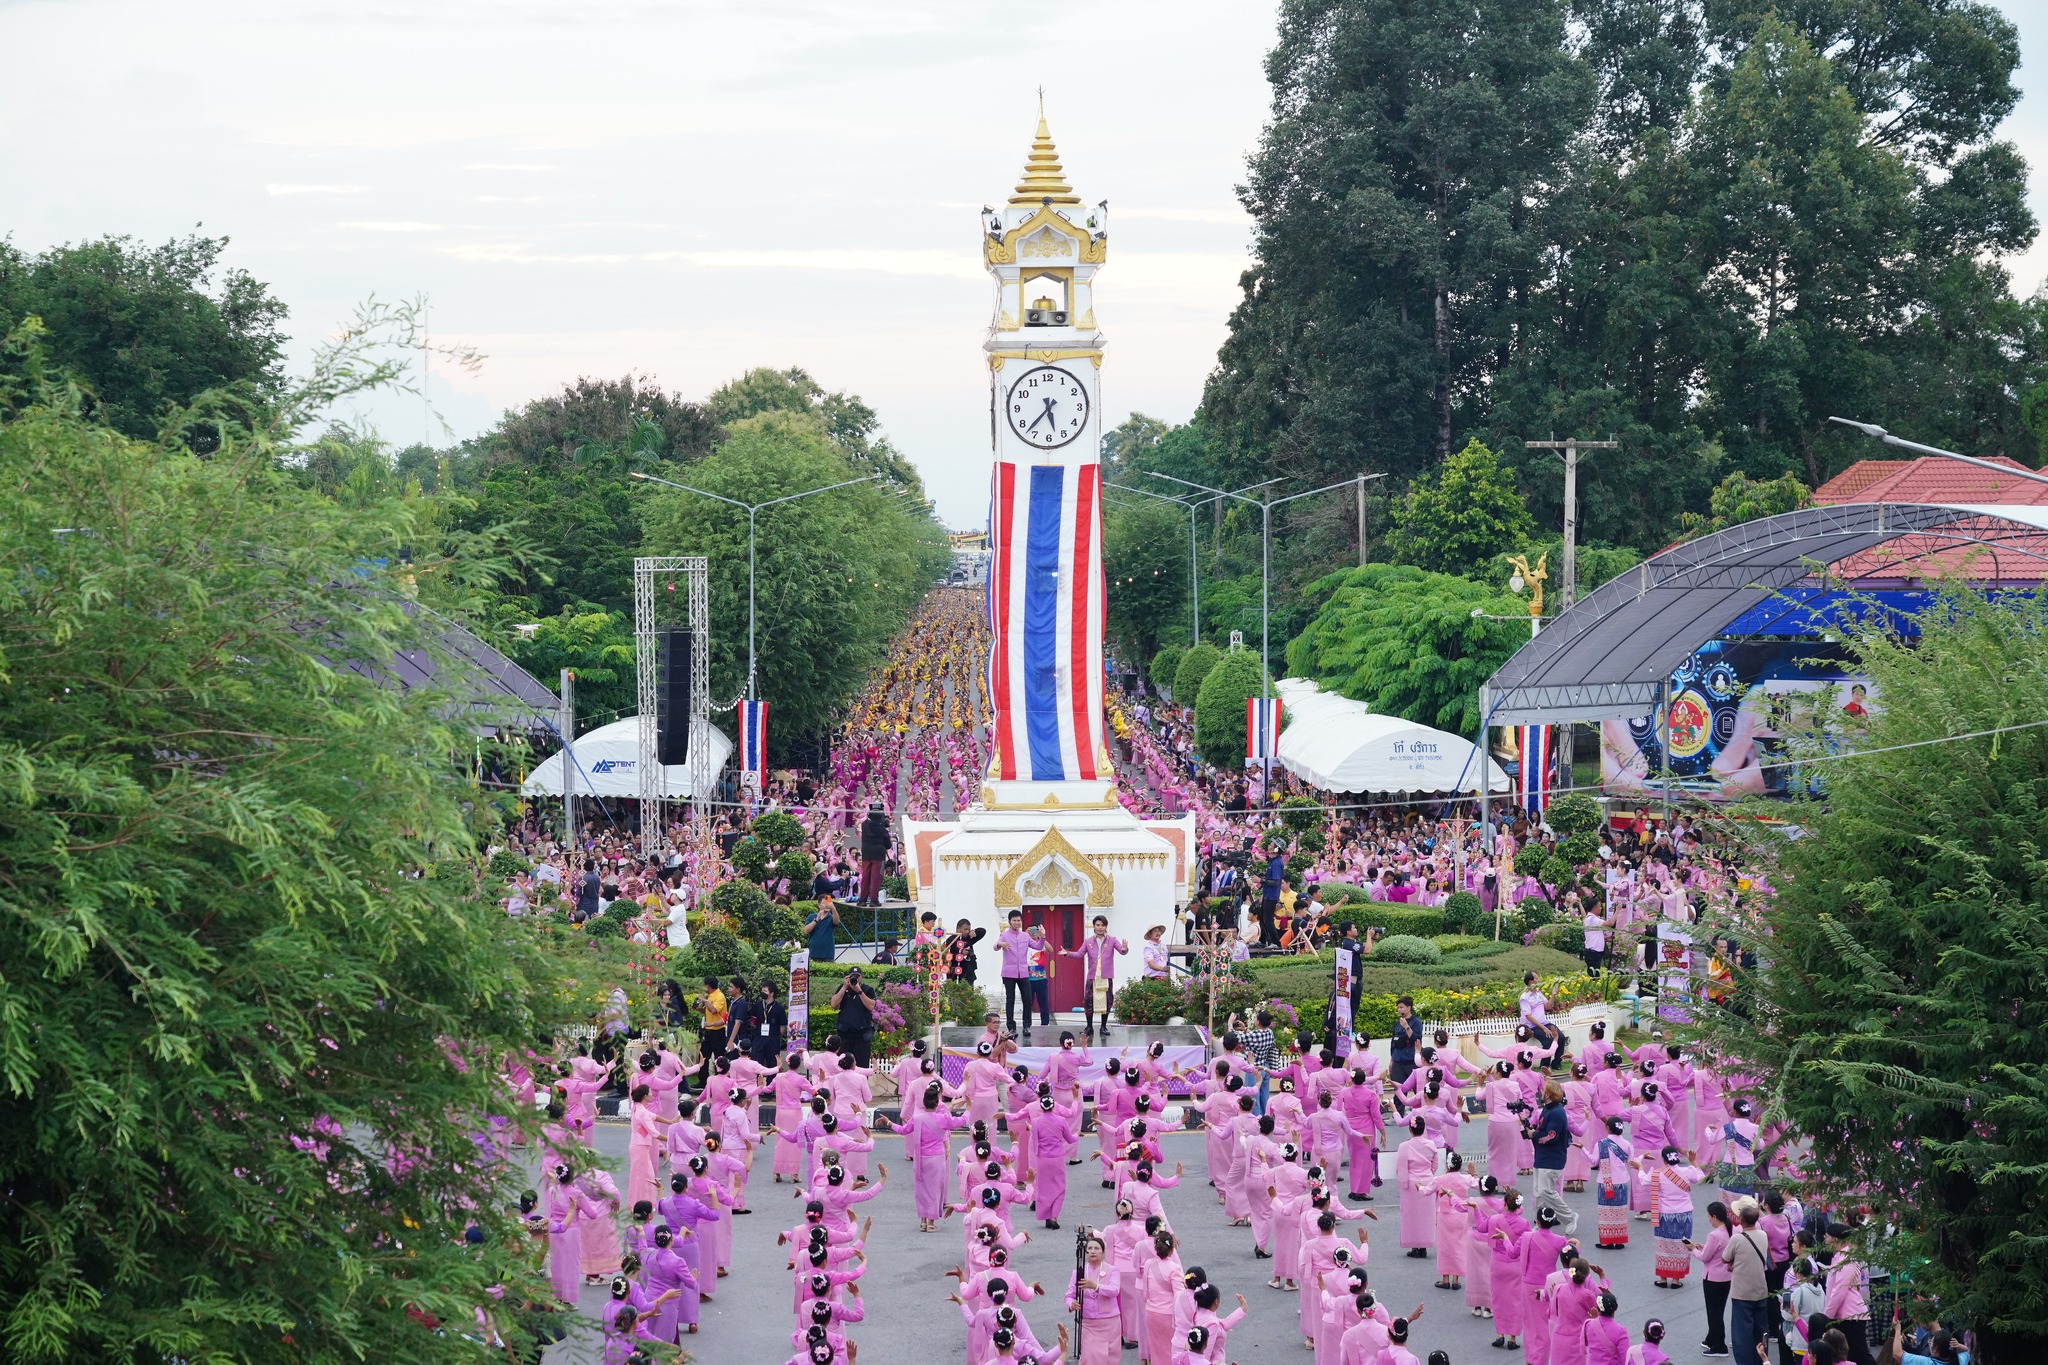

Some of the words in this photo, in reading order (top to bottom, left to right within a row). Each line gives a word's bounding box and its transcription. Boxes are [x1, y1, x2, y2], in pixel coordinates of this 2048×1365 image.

[1042, 373, 1054, 382] 12
[1060, 377, 1065, 385] 1
[1028, 378, 1039, 387] 11
[1018, 390, 1029, 399] 10
[1070, 388, 1078, 396] 2
[1014, 404, 1021, 413] 9
[1076, 403, 1083, 411] 3
[1019, 419, 1026, 428] 8
[1070, 418, 1078, 427] 4
[1031, 430, 1039, 439] 7
[1045, 434, 1053, 442] 6
[1060, 429, 1068, 438] 5
[1410, 740, 1438, 753] บริการ
